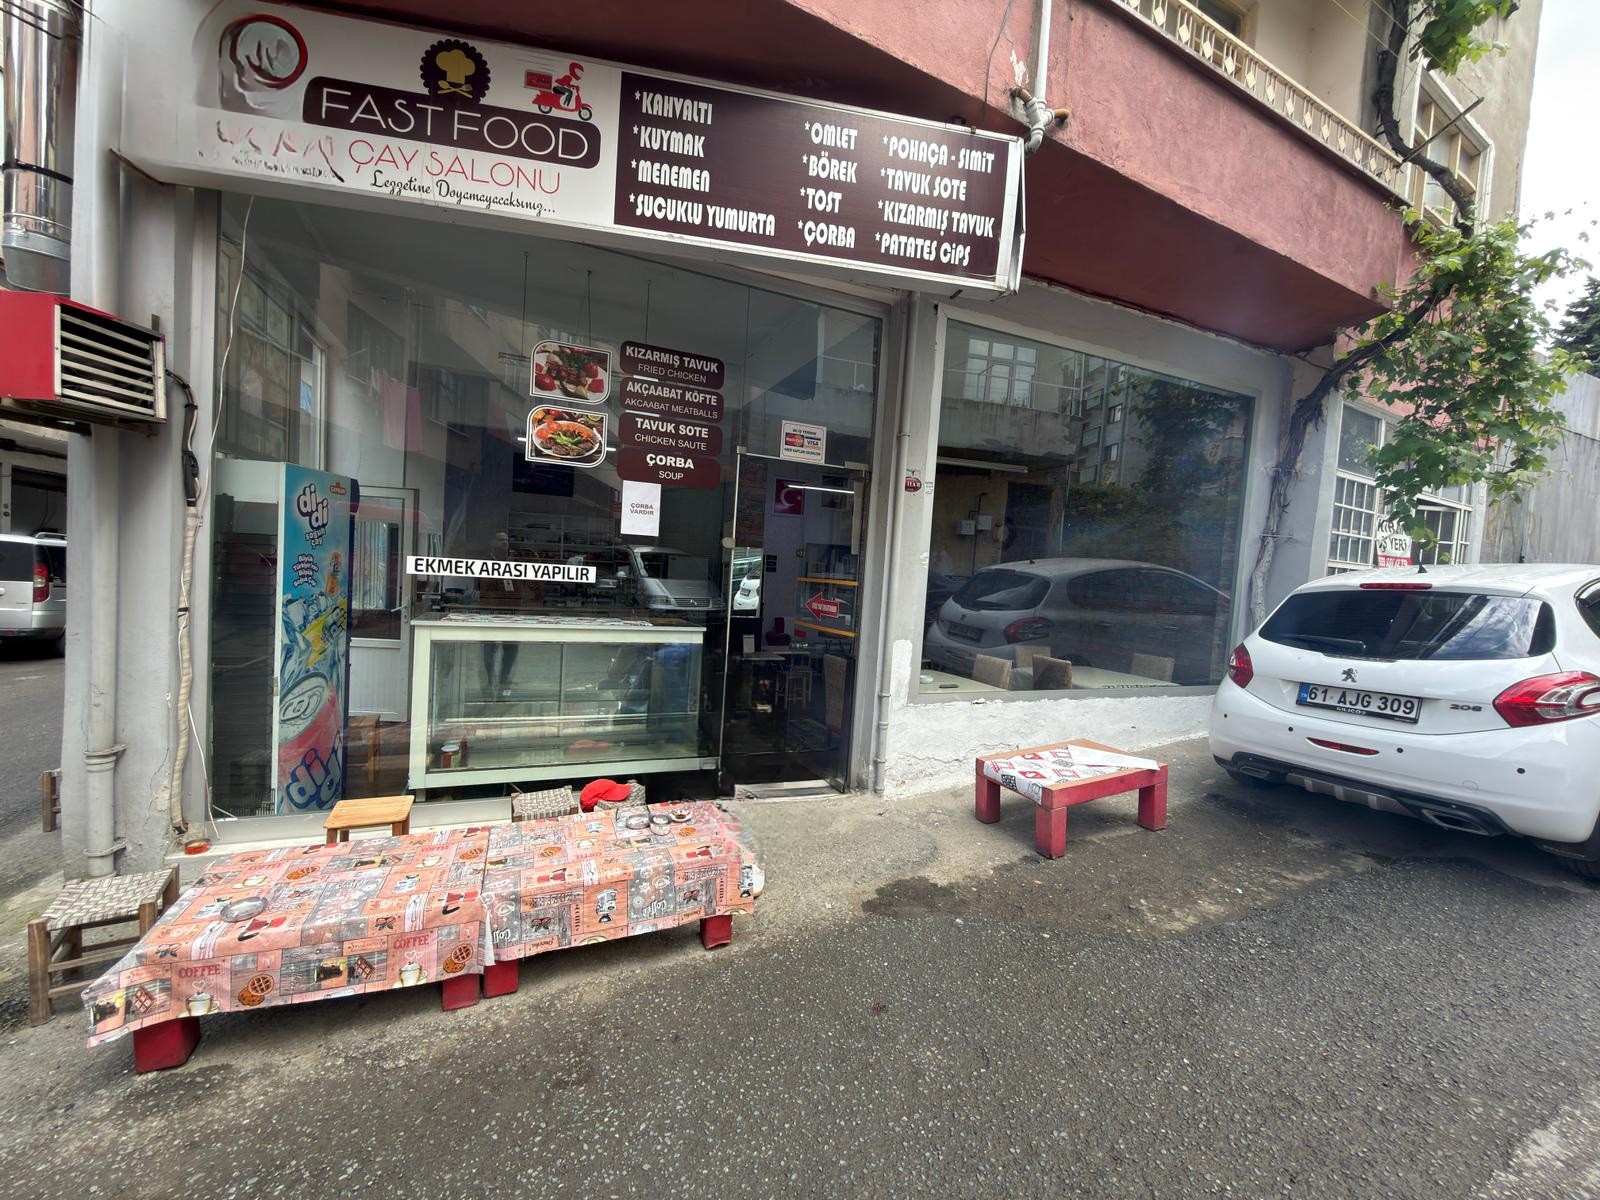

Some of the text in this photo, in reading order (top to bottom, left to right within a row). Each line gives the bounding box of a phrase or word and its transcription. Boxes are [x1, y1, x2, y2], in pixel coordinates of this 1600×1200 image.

[641, 91, 713, 125] KAHVALTI
[322, 87, 589, 161] FAST FOOD
[810, 122, 858, 150] OMLET
[639, 125, 706, 158] KUYMAK
[888, 135, 949, 169] POHAÇA
[348, 139, 419, 174] ÇAY
[425, 151, 561, 194] SALONU
[637, 159, 711, 193] MENEMEN
[808, 150, 858, 183] BÖREK
[370, 169, 432, 196] Lezzetine
[886, 167, 968, 201] TAVUK SOTE
[806, 187, 842, 213] TOST
[635, 193, 776, 237] SUCUKLU YUMURTA
[883, 200, 996, 238] KIZARMIŞ TAVUK
[803, 220, 856, 249] ÇORBA
[880, 232, 938, 262] PATATES
[625, 345, 719, 374] KIZARMIŞ TAVUK
[637, 363, 707, 384] FRIED CHICKEN
[626, 381, 718, 406] AKÇAABAT KÖFTE
[671, 403, 718, 419] MEATBALLS
[635, 417, 709, 438] TAVUK SOTE
[634, 433, 708, 451] CHICKEN SAUTE
[645, 453, 695, 470] ÇORBA
[658, 470, 684, 480] SOUP
[630, 502, 654, 510] ÇORBA
[414, 557, 590, 582] EKMEK ARASI YAPILIR
[1308, 686, 1328, 703] 61
[1336, 690, 1372, 709] AJG
[1377, 696, 1416, 715] 309
[1449, 703, 1483, 712] 208
[641, 898, 668, 919] Coffee
[393, 934, 430, 949] COFFEE
[178, 963, 221, 978] COFFEE
